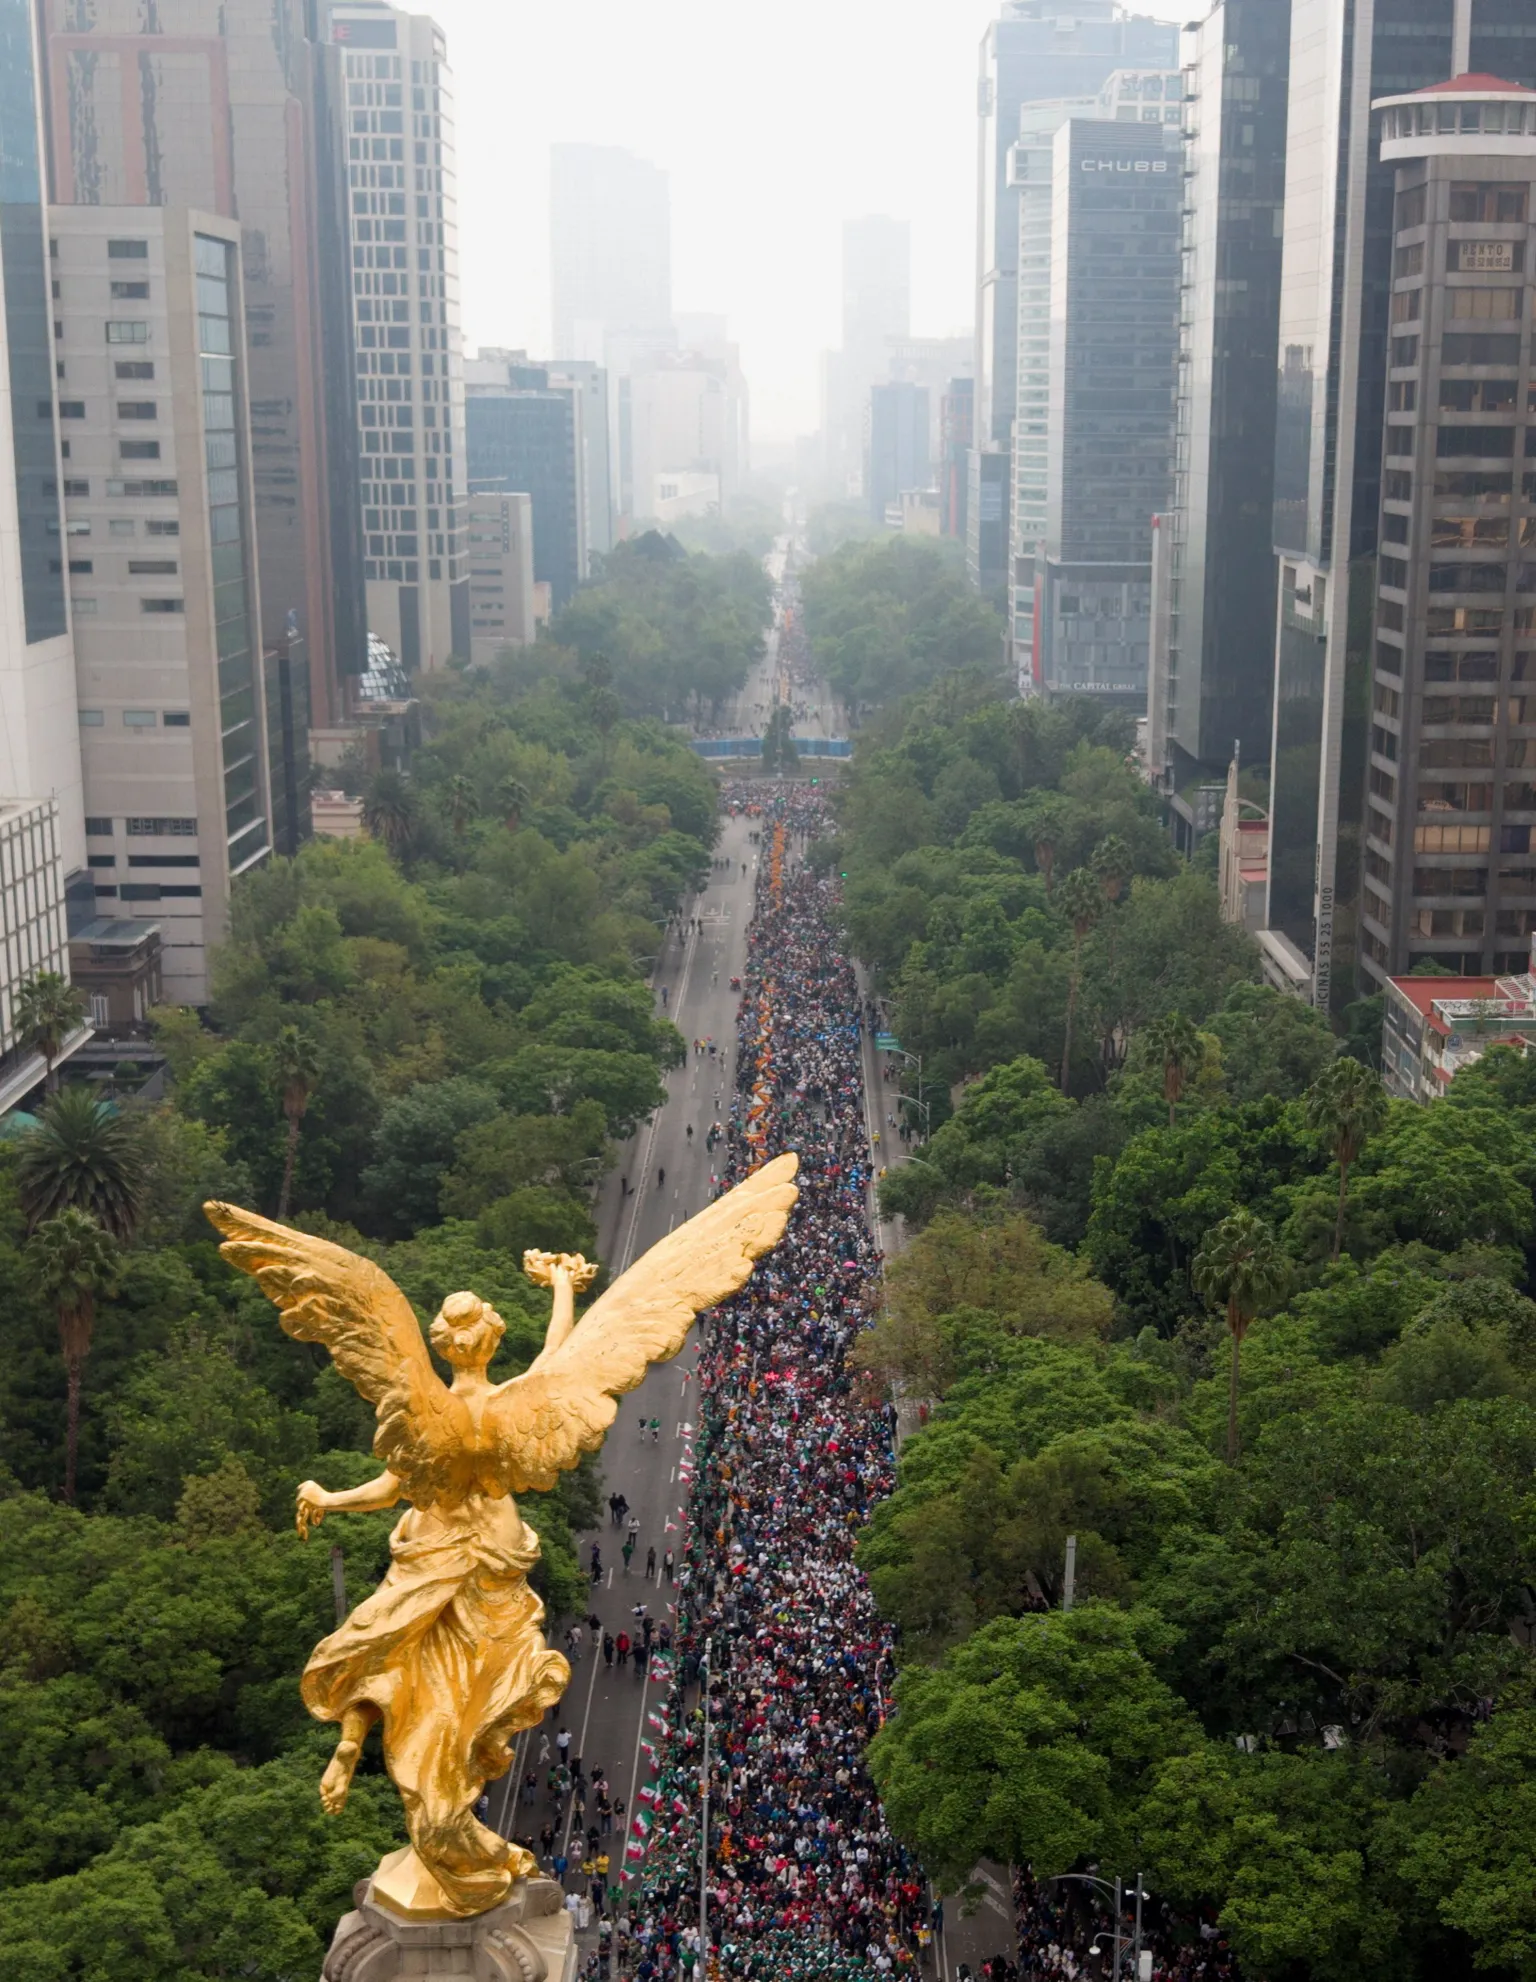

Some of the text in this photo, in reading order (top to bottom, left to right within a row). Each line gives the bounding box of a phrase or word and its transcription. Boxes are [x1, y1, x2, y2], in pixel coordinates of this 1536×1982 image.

[1081, 160, 1167, 172] CHUBB
[1074, 682, 1110, 690] CAPITAL
[1322, 887, 1333, 916] 1000
[1321, 922, 1331, 936] 25
[1320, 942, 1330, 956] 55
